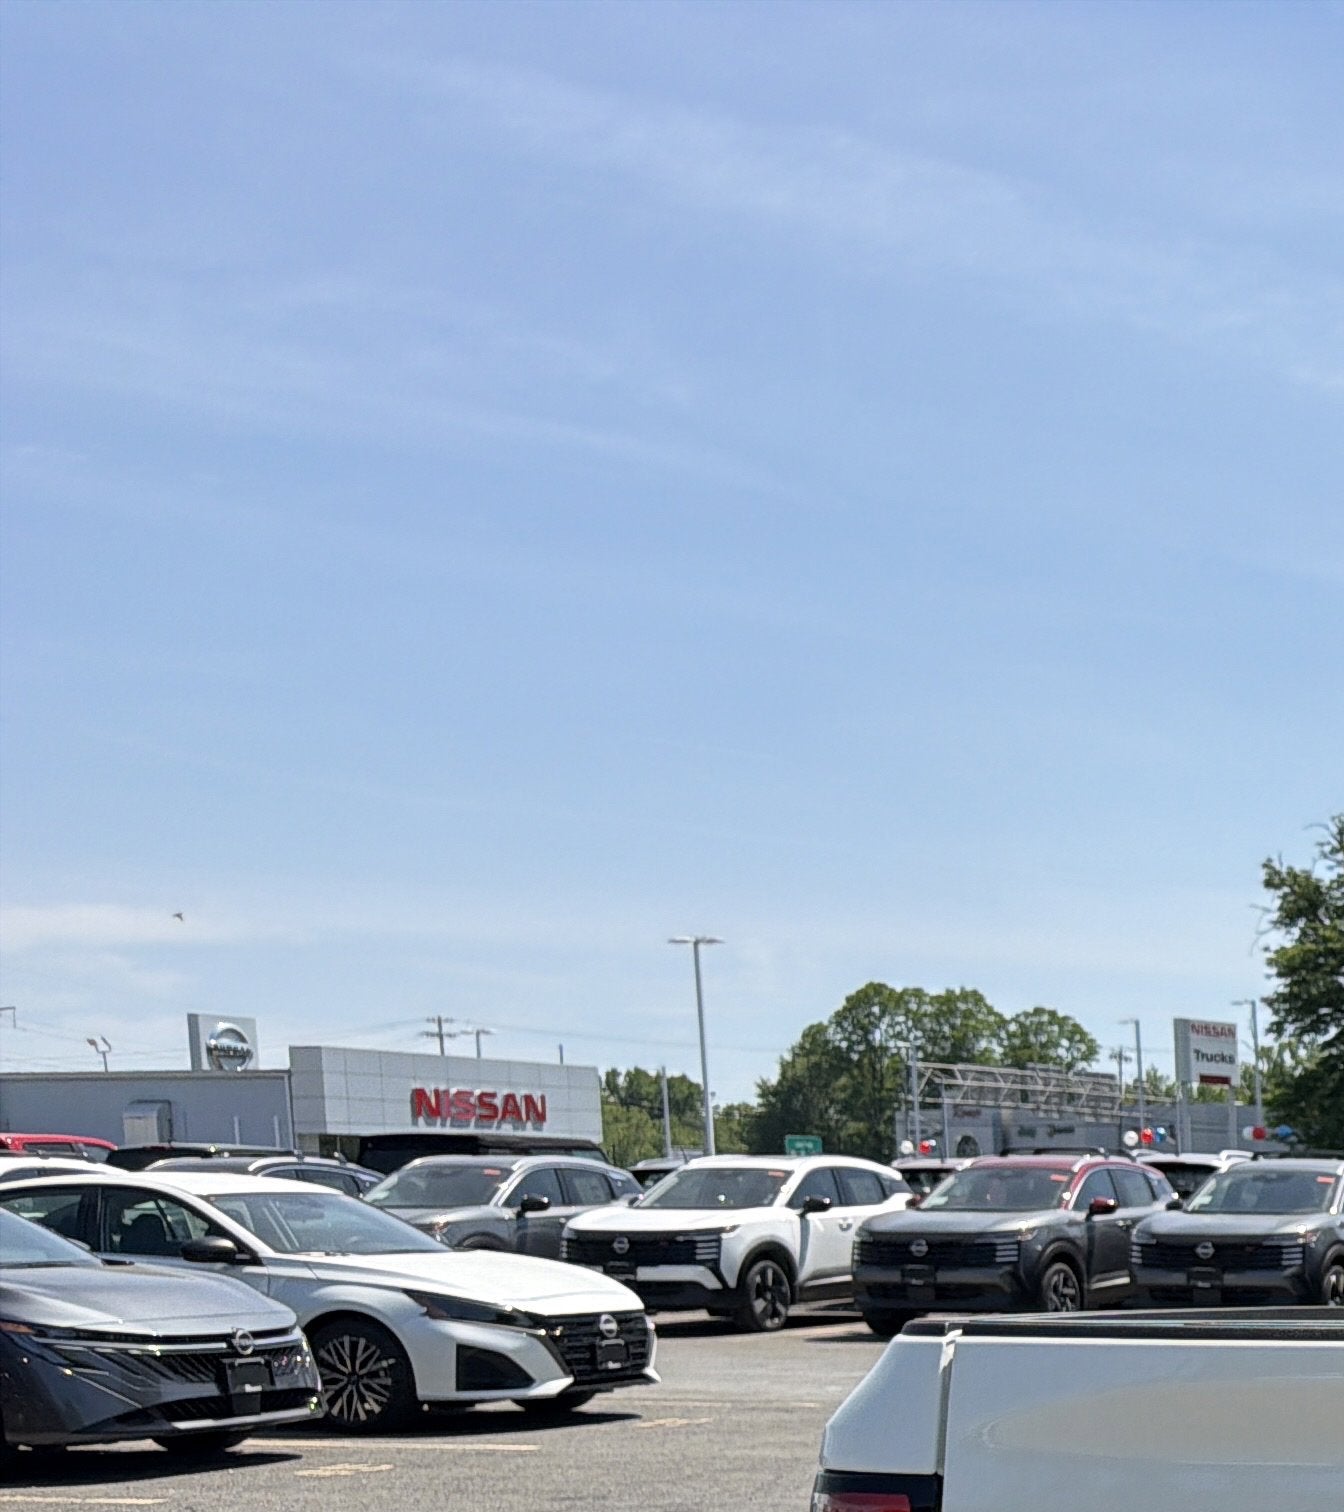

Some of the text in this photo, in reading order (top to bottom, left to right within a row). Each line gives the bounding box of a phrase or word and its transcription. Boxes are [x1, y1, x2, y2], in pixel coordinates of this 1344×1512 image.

[1190, 1023, 1235, 1038] NISSAN
[1193, 1048, 1235, 1065] Trucks
[410, 1087, 547, 1127] NISSAN
